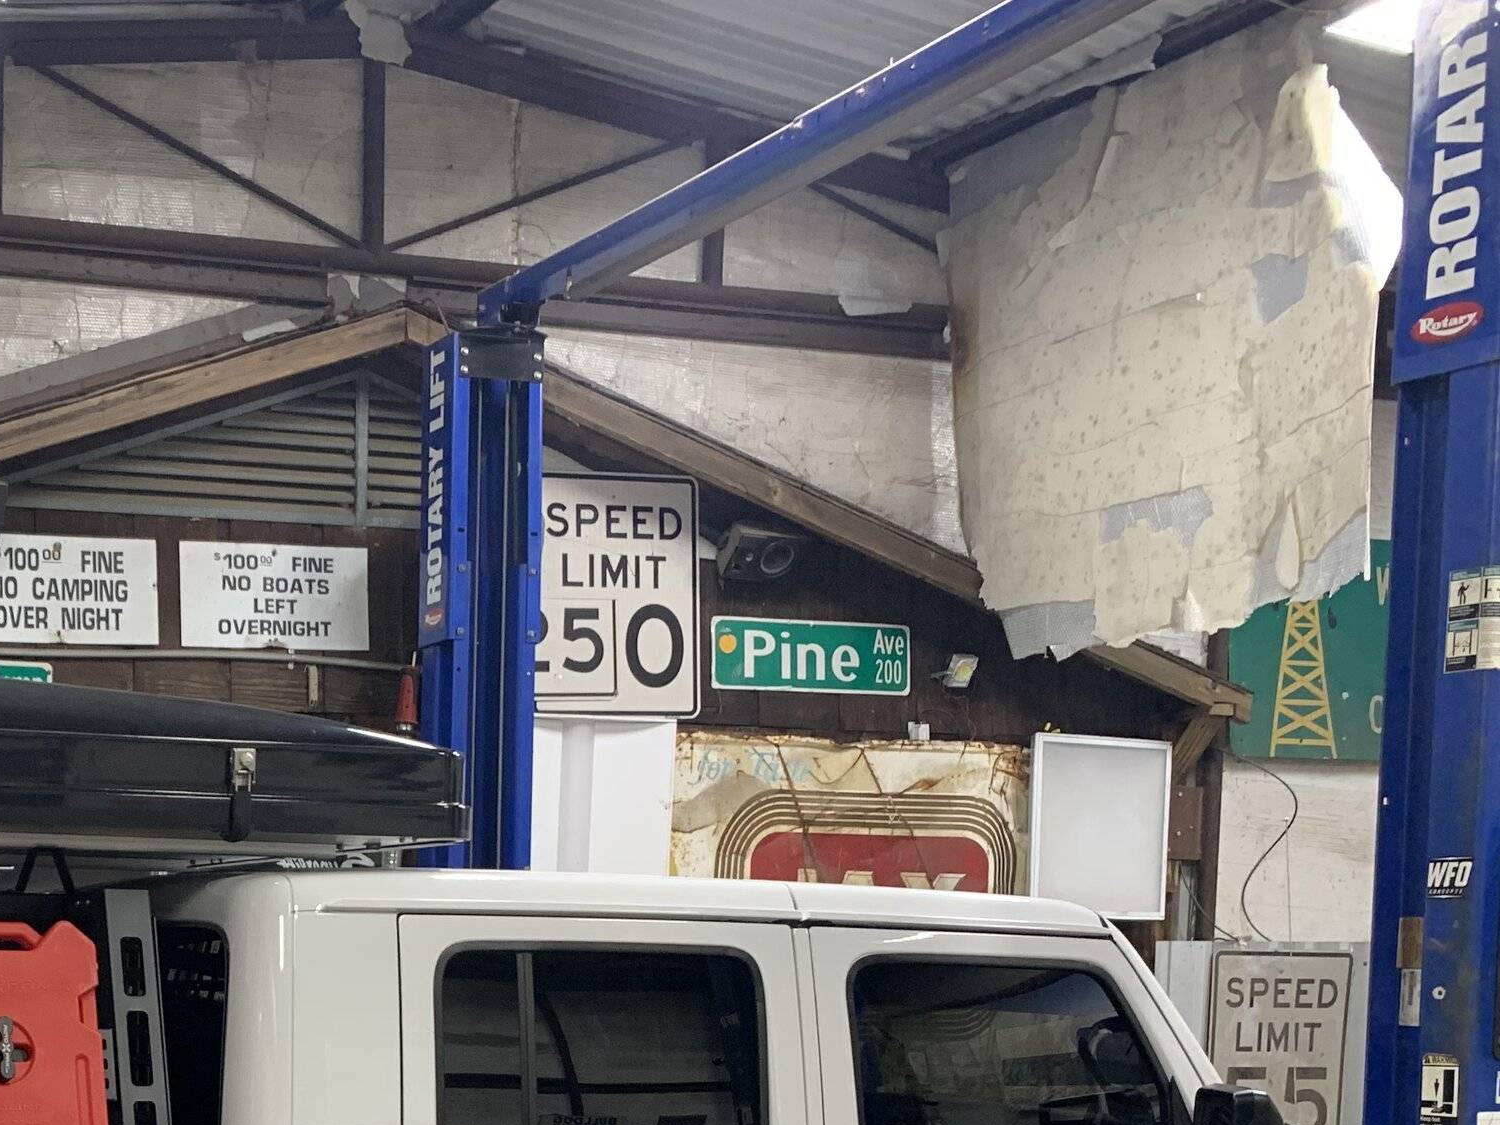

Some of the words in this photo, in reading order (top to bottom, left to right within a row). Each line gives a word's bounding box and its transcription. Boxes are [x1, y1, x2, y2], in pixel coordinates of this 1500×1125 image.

[1424, 29, 1488, 300] ROTAR
[1419, 310, 1477, 338] Rotary
[429, 349, 447, 434] LIFT
[425, 449, 447, 607] ROTARY
[546, 501, 683, 541] SPEED
[80, 550, 125, 573] FINE
[291, 556, 335, 574] FINE
[561, 553, 667, 590] LIMIT
[31, 578, 129, 603] CAMPING
[221, 575, 252, 592] NO
[262, 577, 330, 595] BOATS
[60, 607, 125, 632] NIGHT
[253, 598, 298, 616] LEFT
[217, 618, 333, 638] OVERNIGHT
[743, 628, 860, 683] Pine
[872, 628, 905, 657] Ave
[874, 659, 903, 685] 200
[1426, 860, 1473, 888] WFO
[1428, 888, 1464, 896] CONCEPTS
[1224, 976, 1340, 1009] SPEED
[1234, 1021, 1323, 1055] LIMIT
